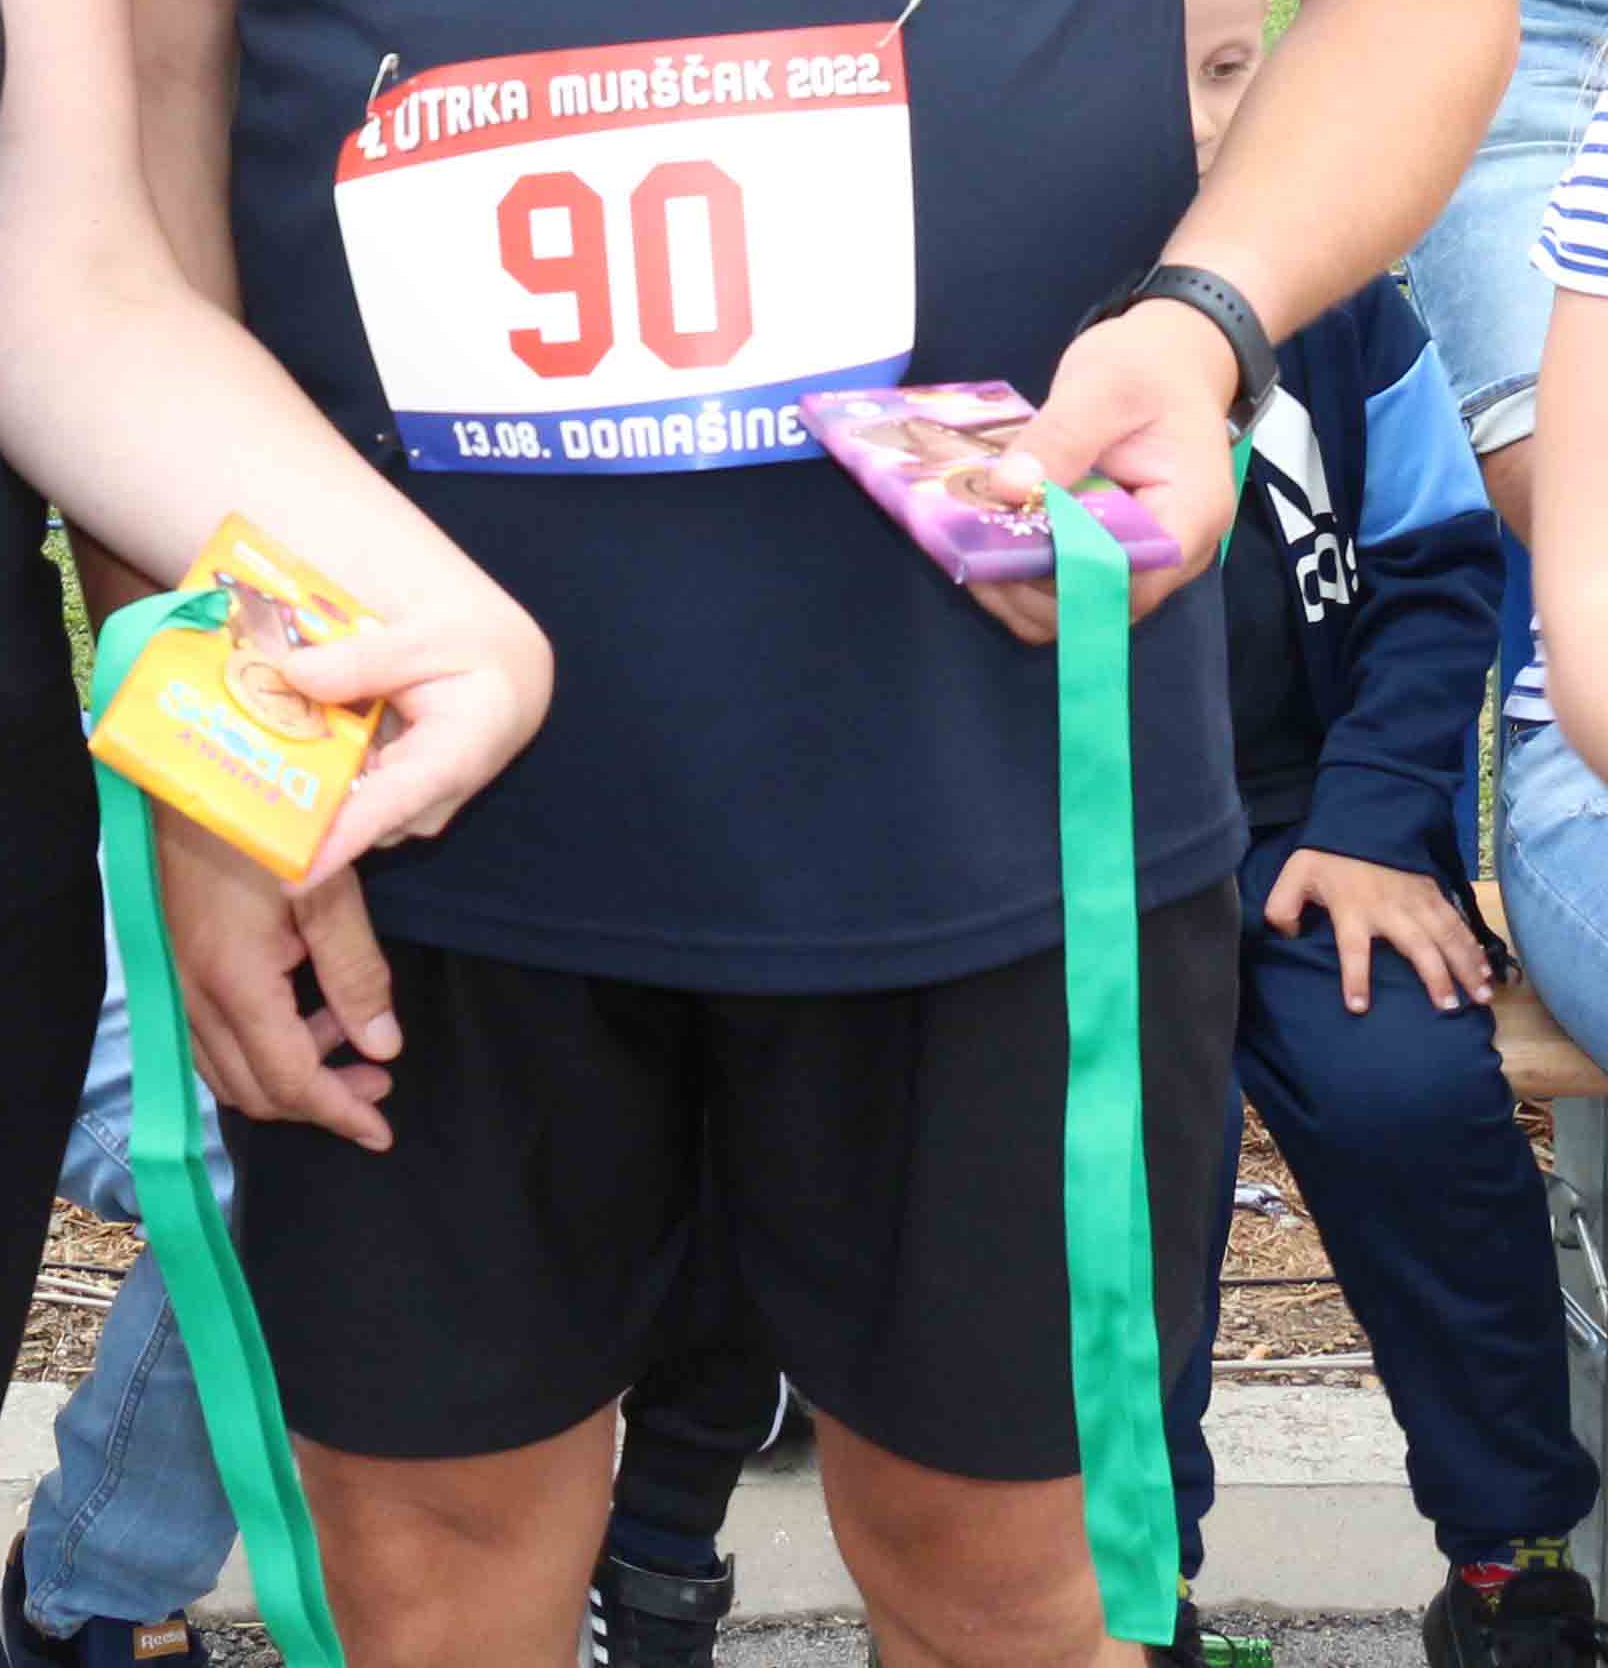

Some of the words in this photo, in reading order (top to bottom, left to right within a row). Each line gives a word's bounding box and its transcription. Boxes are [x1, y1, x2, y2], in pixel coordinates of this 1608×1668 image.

[393, 79, 529, 153] UTRKA
[548, 54, 775, 117] MURŠČAK
[496, 159, 753, 379] 90
[452, 420, 552, 459] 13.08.
[559, 400, 807, 460] DOMAŠINE
